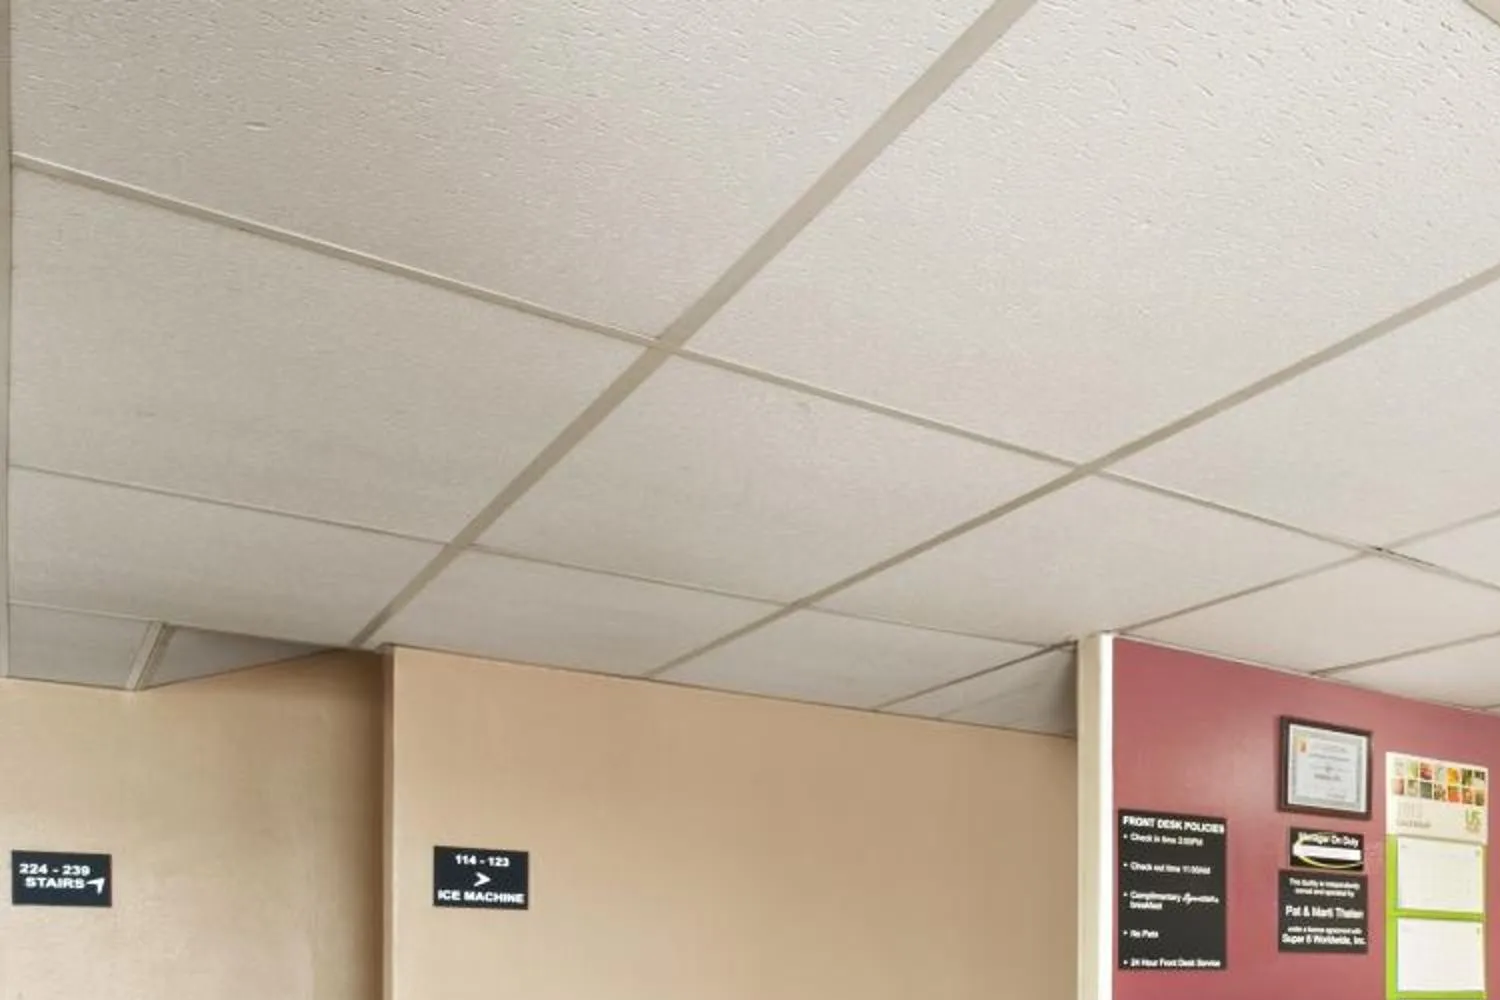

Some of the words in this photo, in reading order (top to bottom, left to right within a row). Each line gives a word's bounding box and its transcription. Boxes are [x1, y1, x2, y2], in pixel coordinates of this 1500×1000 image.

[1123, 815, 1155, 828] FRONT
[1157, 818, 1183, 830] DESK
[1184, 821, 1225, 834] POLICIES
[1130, 833, 1153, 843] Check
[455, 854, 477, 865] 114
[488, 856, 510, 867] 123
[1130, 861, 1153, 872] Check
[19, 863, 49, 875] 224
[62, 864, 91, 876] 239
[25, 876, 85, 889] STAIRS
[437, 889, 460, 901] ICE
[463, 891, 525, 904] MACHINE
[1141, 929, 1159, 939] Pets
[1281, 933, 1305, 945] Super
[1159, 957, 1177, 967] Front
[1178, 957, 1195, 967] Desk
[1196, 957, 1221, 967] Service
